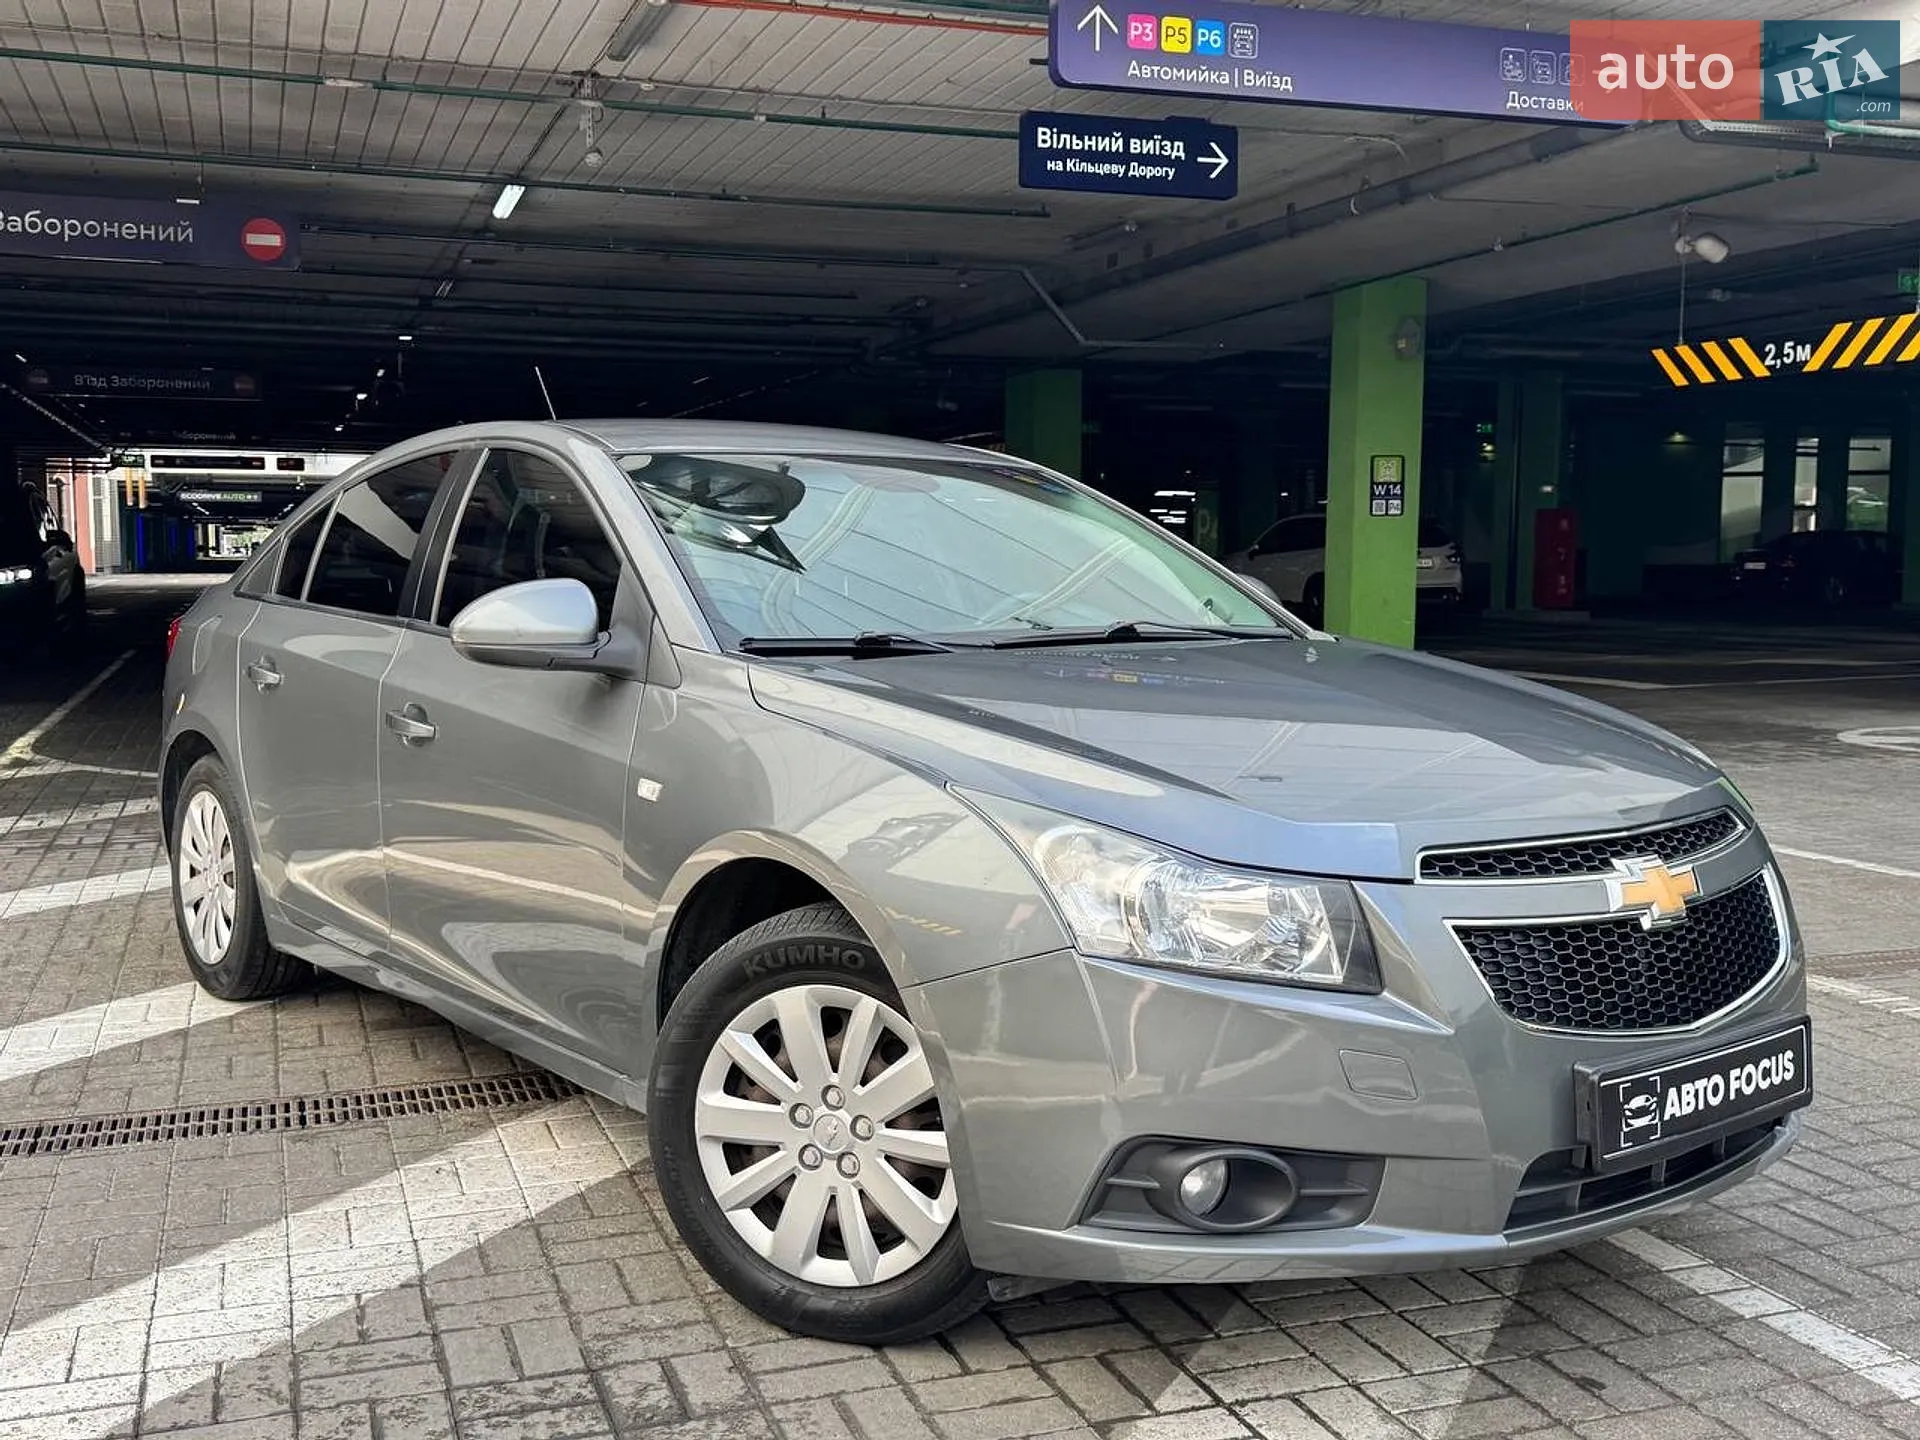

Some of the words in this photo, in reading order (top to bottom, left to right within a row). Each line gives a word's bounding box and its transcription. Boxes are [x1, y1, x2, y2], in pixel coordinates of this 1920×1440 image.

[1130, 22, 1153, 42] P3
[1165, 25, 1188, 45] P5
[1197, 29, 1221, 48] P6
[1127, 60, 1230, 84] Автомийка
[1243, 70, 1293, 92] Виїзд
[1036, 126, 1123, 153] Вільний
[1129, 135, 1185, 160] виїзд
[1046, 158, 1064, 172] на
[1066, 158, 1126, 177] Кільцеву
[1128, 162, 1176, 180] Дорогу
[0, 210, 194, 243] аборонений
[742, 944, 866, 979] KUMHO
[1729, 1050, 1795, 1100] FOCUS
